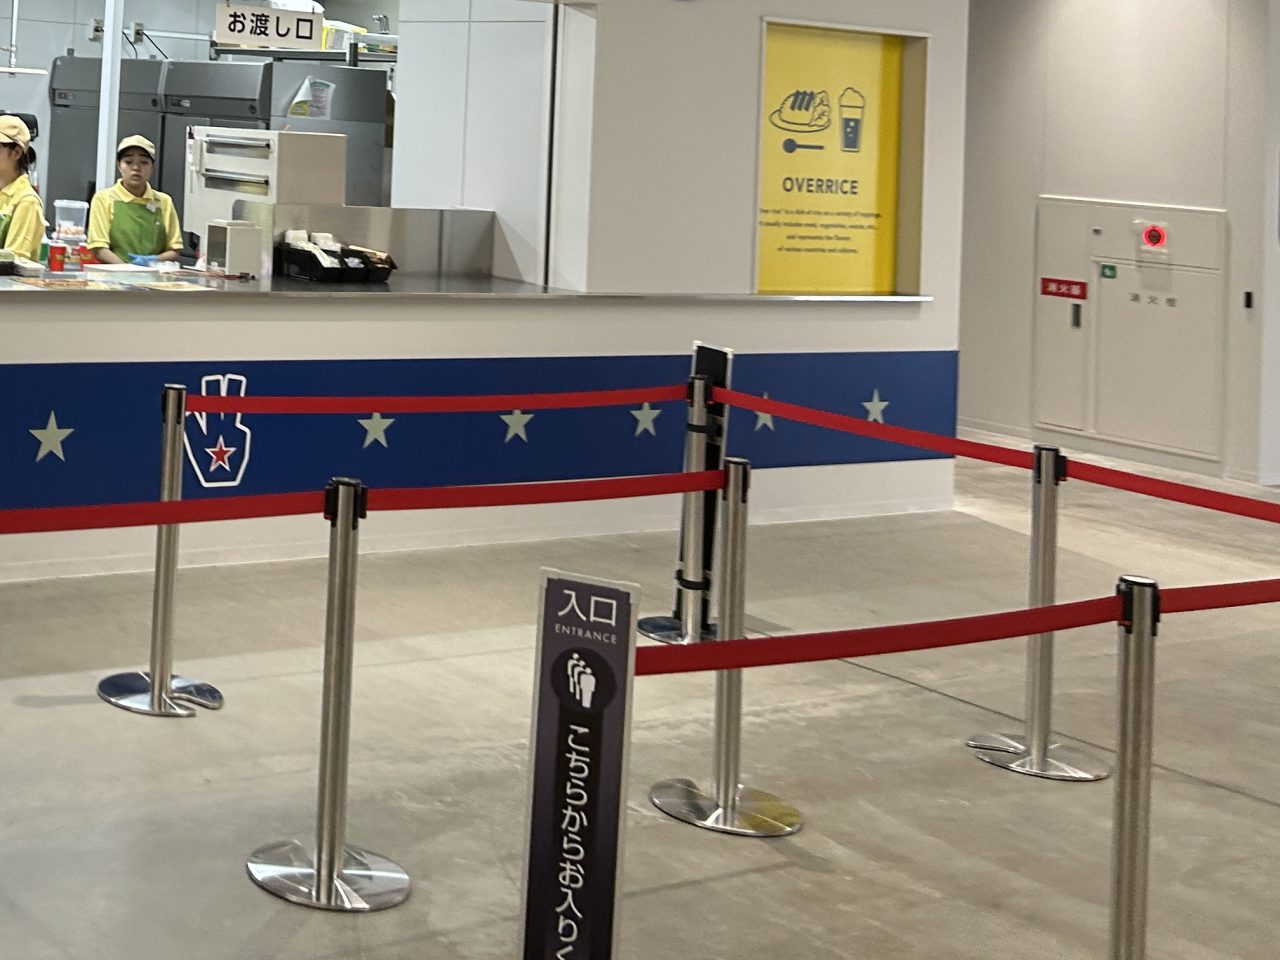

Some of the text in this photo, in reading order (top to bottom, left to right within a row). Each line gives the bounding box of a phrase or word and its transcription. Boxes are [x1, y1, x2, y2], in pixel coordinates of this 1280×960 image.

[228, 12, 314, 40] お渡し口
[782, 177, 858, 195] OVERRICE
[558, 589, 617, 626] 入口
[554, 623, 617, 645] ENTRANCE
